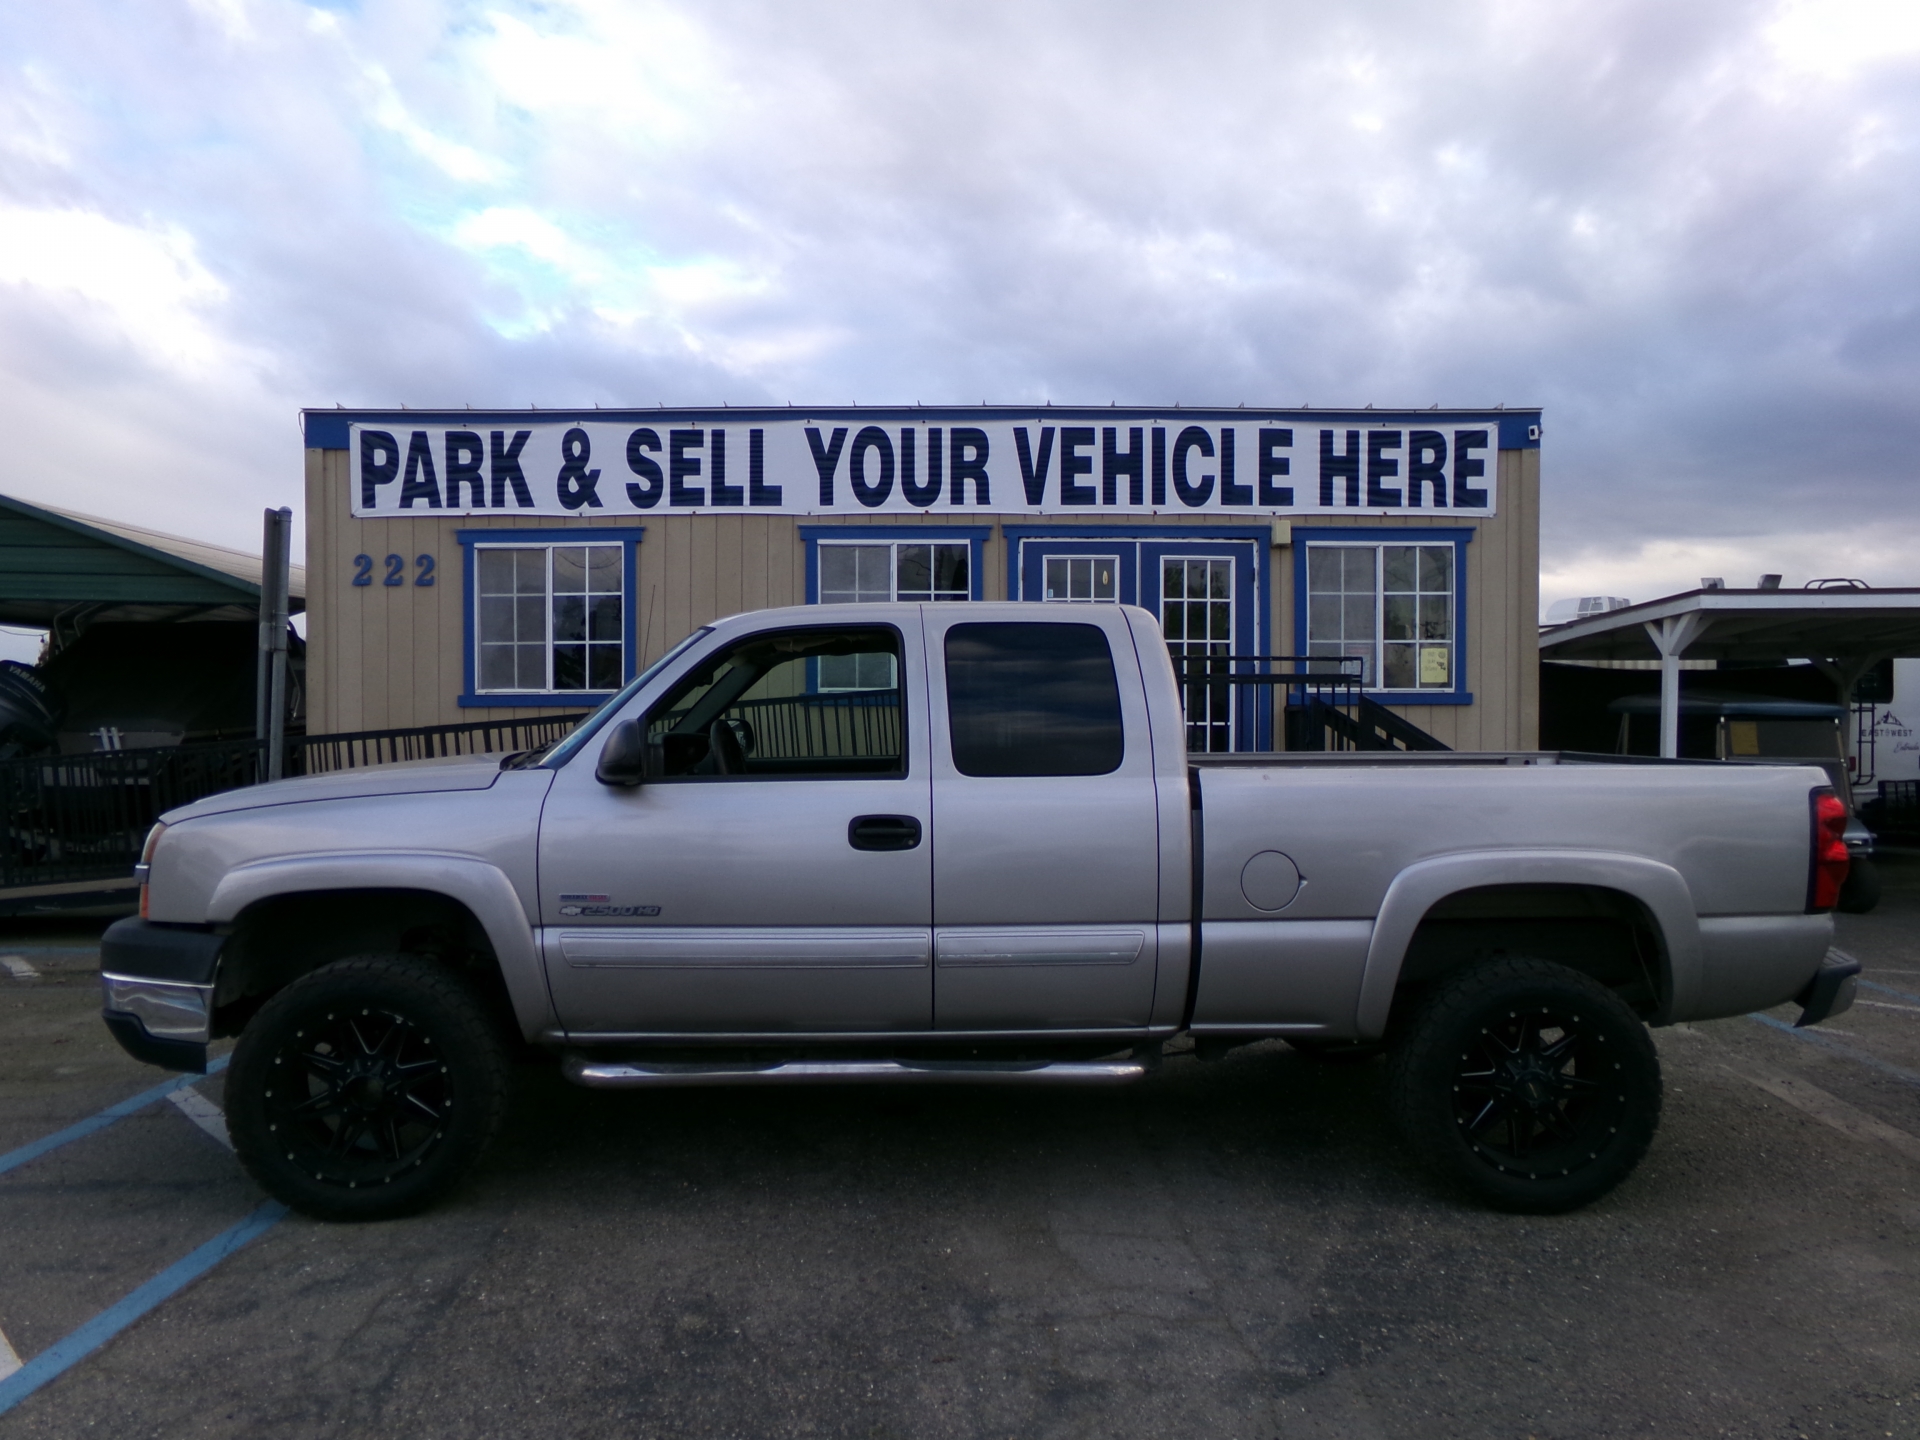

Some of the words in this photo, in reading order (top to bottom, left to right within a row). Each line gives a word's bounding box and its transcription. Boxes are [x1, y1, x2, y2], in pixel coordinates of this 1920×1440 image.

[360, 430, 535, 508] PARK
[557, 428, 603, 510] &
[626, 428, 782, 509] SELL
[804, 426, 990, 507] YOUR
[1013, 425, 1293, 506] VEHICLE
[1320, 430, 1488, 508] HERE
[353, 554, 434, 586] 222
[9, 665, 46, 693] YAMAHA
[1891, 729, 1913, 737] WEST
[584, 906, 635, 916] 2500
[636, 906, 660, 916] HD
